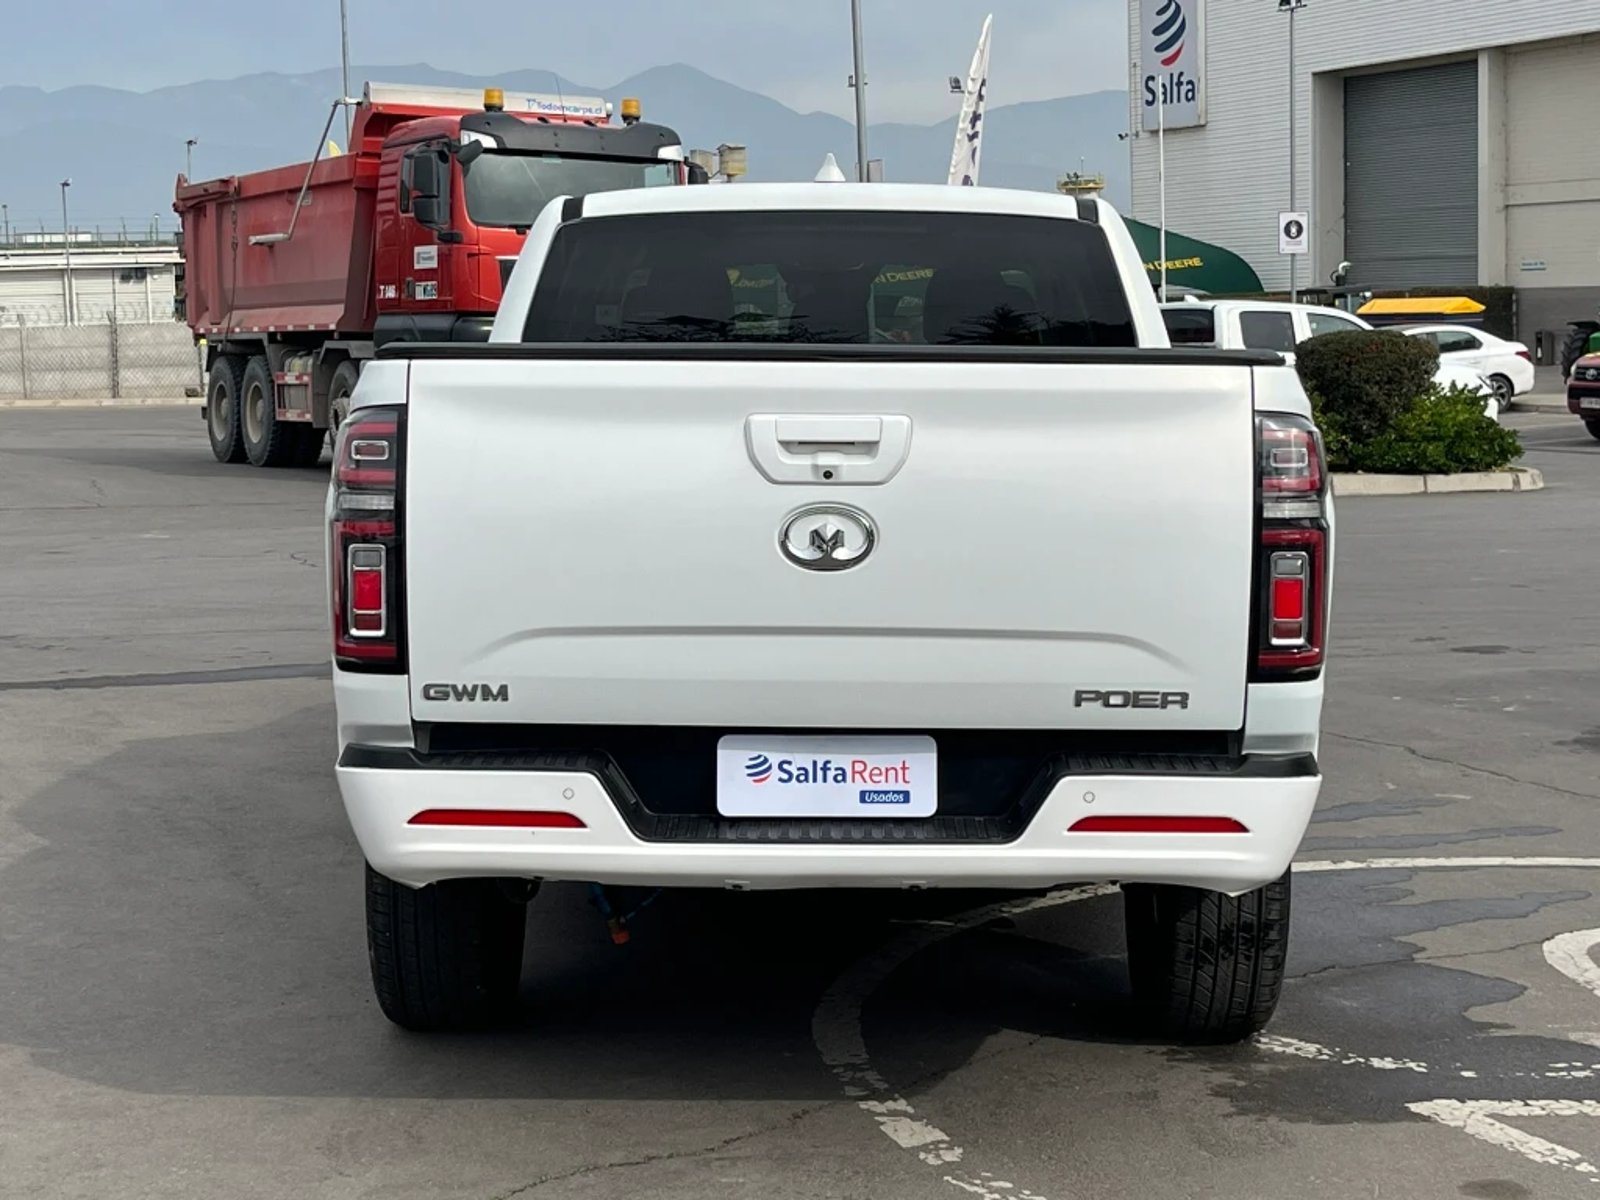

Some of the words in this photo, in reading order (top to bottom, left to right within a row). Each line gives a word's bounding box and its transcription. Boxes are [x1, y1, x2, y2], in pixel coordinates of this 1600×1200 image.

[1145, 71, 1196, 107] Salfa
[423, 683, 509, 702] GWM
[1074, 690, 1190, 709] POER
[865, 791, 905, 803] Usados
